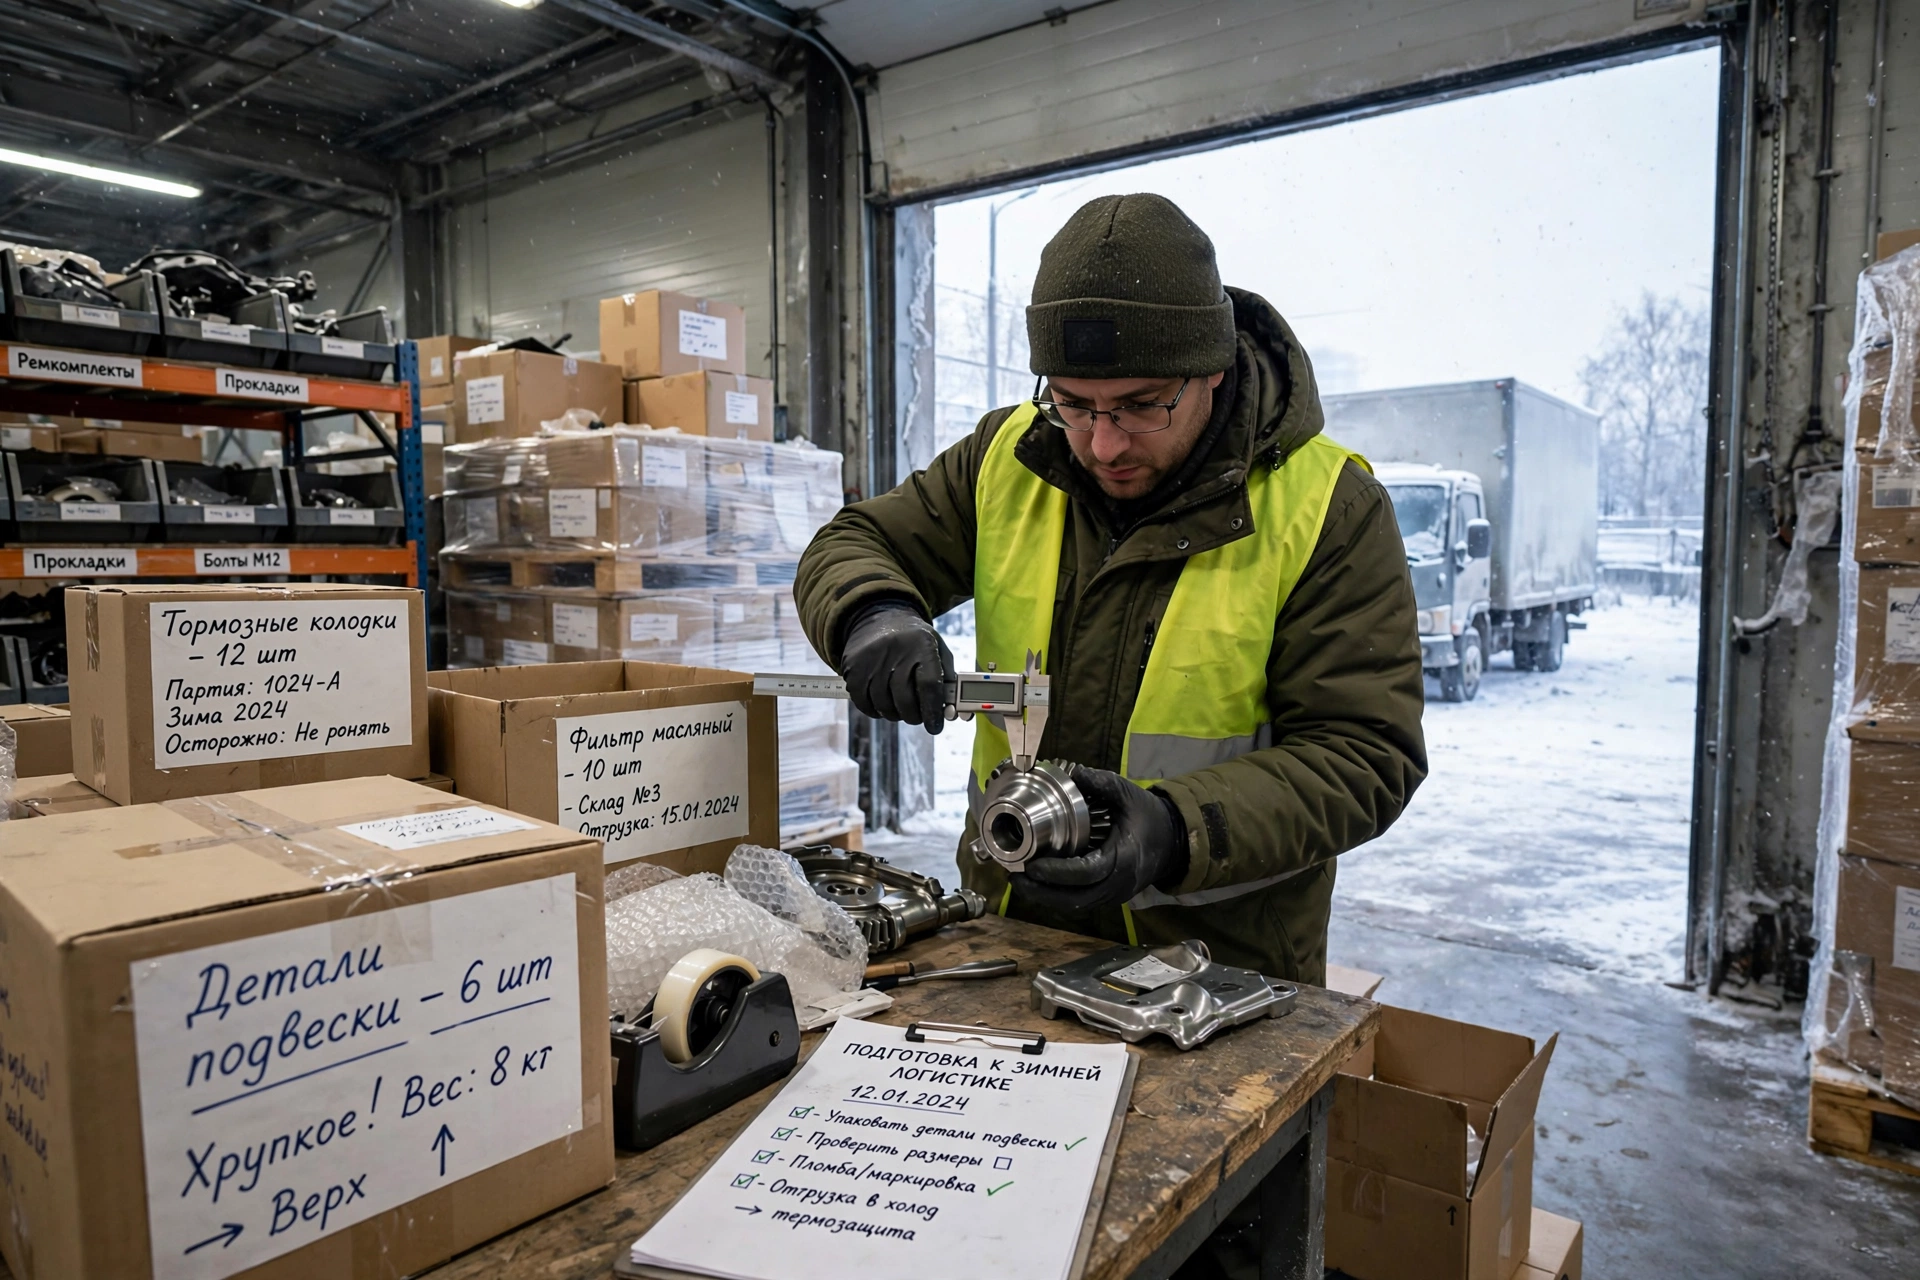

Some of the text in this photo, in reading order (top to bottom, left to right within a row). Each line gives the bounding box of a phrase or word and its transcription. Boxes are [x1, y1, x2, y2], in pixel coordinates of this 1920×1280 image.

[17, 352, 135, 379] Ремкомплекты
[225, 373, 300, 396] Прокладки
[33, 553, 126, 574] Прокладки
[203, 552, 248, 568] Болты
[161, 609, 397, 647] Тормозные колодки
[216, 642, 246, 667] 12
[257, 648, 297, 665] шт
[165, 678, 253, 706] Партия:
[165, 699, 288, 729] Зима 2024
[165, 721, 391, 757] Осторожно: Не ронять
[569, 712, 734, 754] Фильтр масляный
[582, 758, 606, 782] 10
[612, 759, 642, 778] шт
[578, 794, 625, 816] Склад
[631, 783, 661, 806] №3
[661, 794, 740, 826] 15.01.2024
[185, 944, 384, 1029] Детали
[186, 998, 401, 1087] подвески
[460, 959, 484, 1004] 6
[497, 955, 553, 994] шт
[842, 1042, 1102, 1082] ПОДГОТОВКА К ЗИМНЕЙ
[889, 1066, 1013, 1091] ЛОГИСТИКЕ
[401, 1069, 476, 1119] Вес:
[490, 1045, 511, 1087] 8
[851, 1085, 970, 1111] 12.01.2024
[824, 1109, 909, 1132] Упаковать
[911, 1125, 976, 1140] детали
[981, 1133, 1057, 1150] подвески
[806, 1131, 899, 1156] Проверить
[903, 1149, 983, 1169] размеры
[789, 1154, 976, 1194] Пломба/маркировка
[268, 1173, 367, 1237] Верх
[769, 1178, 858, 1205] Отгрузка
[866, 1193, 880, 1207] в
[884, 1200, 939, 1222] холод
[771, 1208, 917, 1241] термозащита
